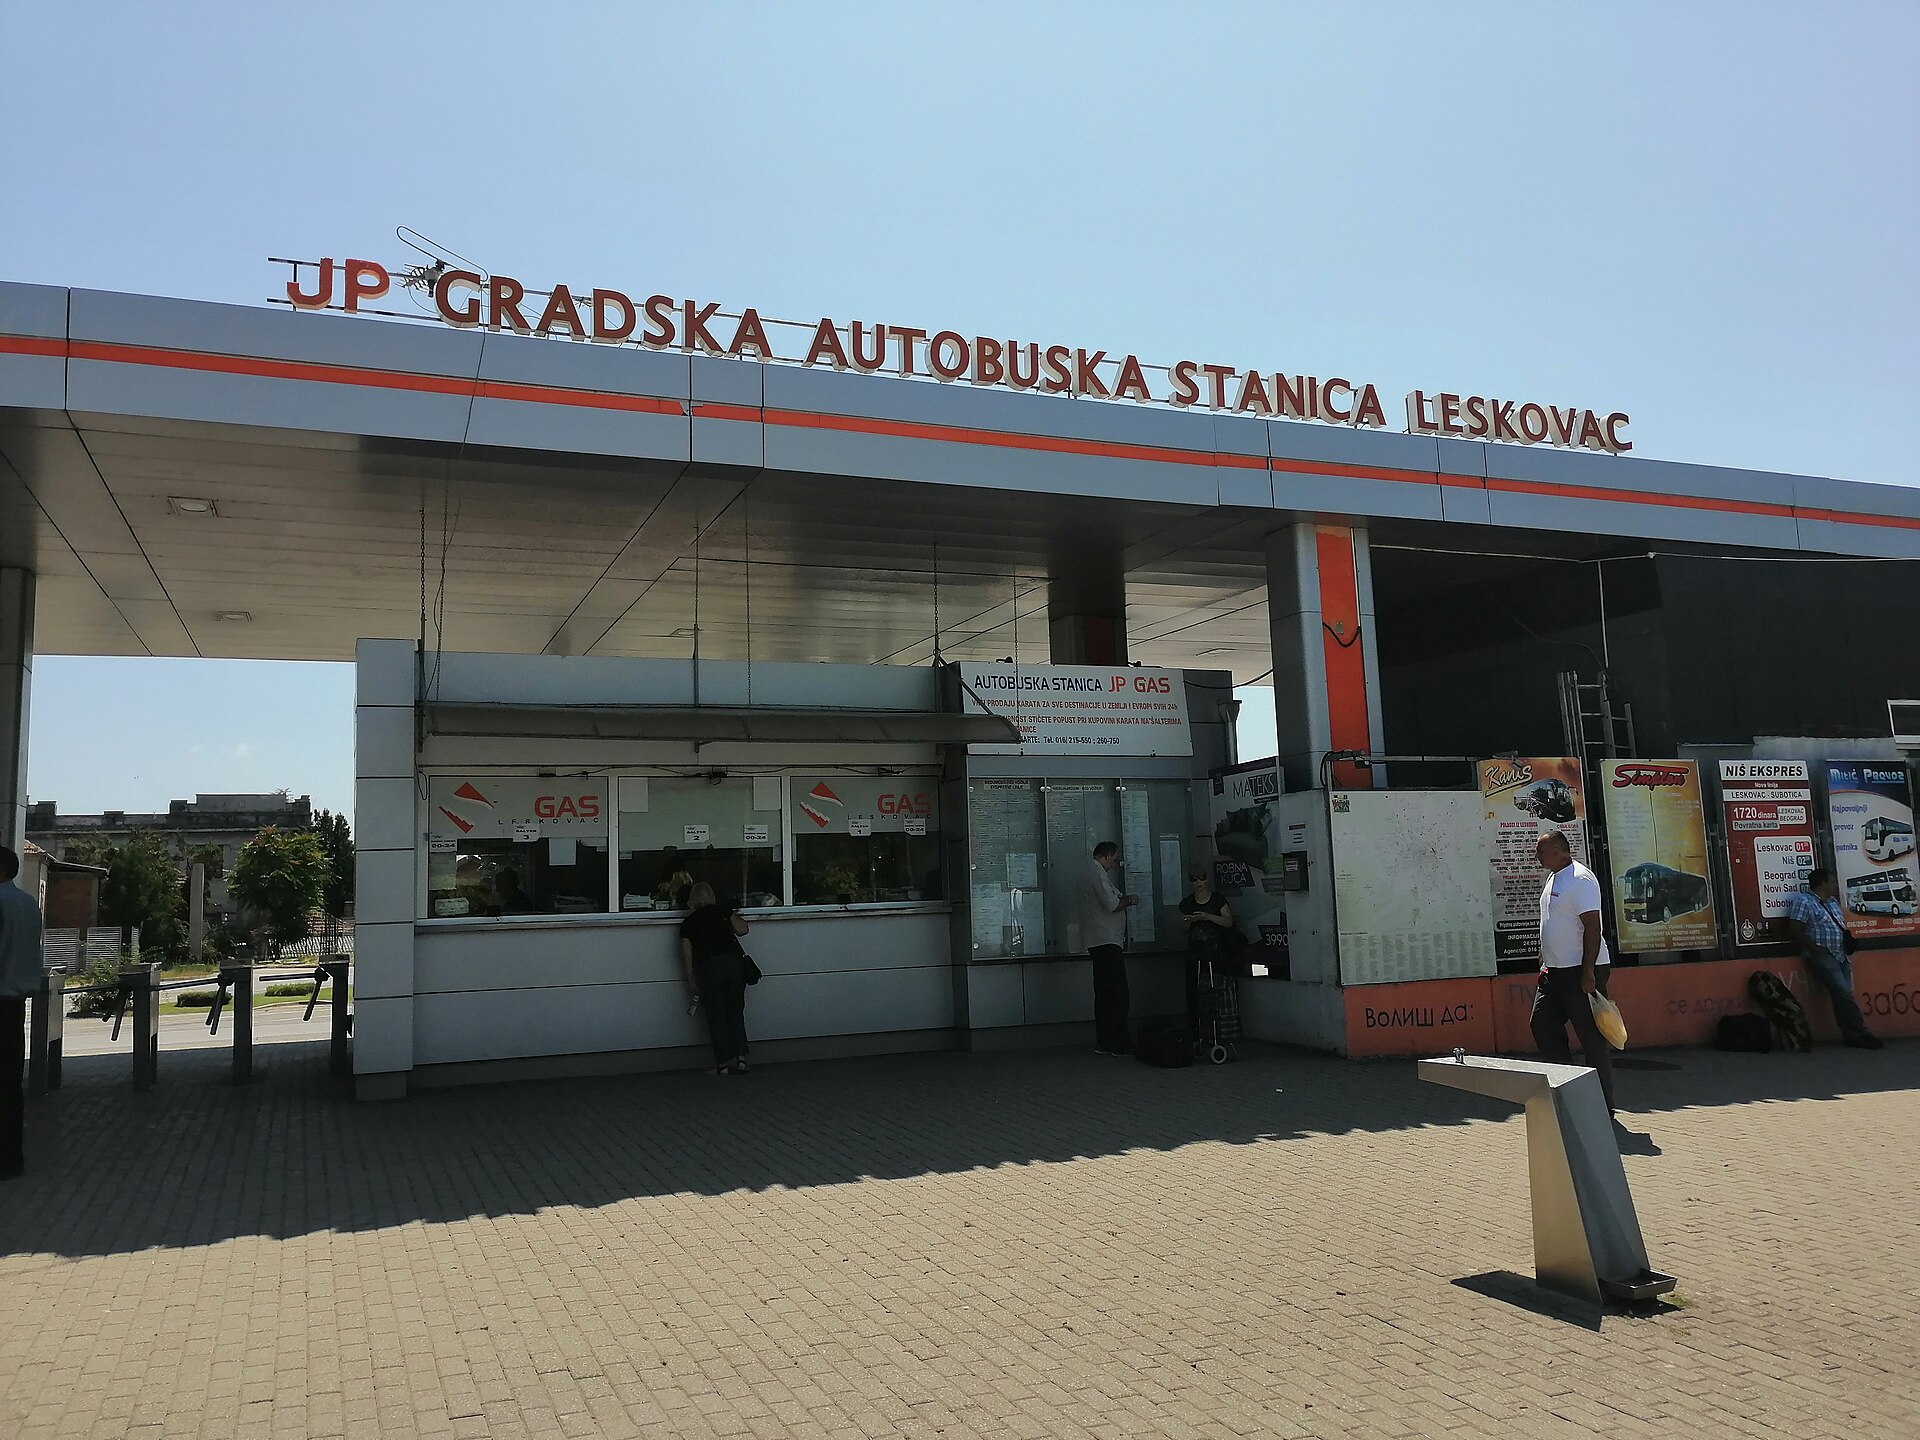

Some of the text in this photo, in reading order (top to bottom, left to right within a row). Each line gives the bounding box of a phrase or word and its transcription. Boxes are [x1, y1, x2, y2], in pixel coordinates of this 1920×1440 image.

[286, 256, 1635, 454] JP GRADSKA AUTOBUSKA STANICA LESKOVAC
[974, 675, 1171, 694] AUTOBUSKA STANICA JP GAS
[987, 699, 1015, 707] PRODAJU
[1017, 699, 1041, 708] KARATA
[1064, 701, 1101, 710] DESTINACIJE
[1053, 716, 1076, 724] POPUST
[1116, 717, 1140, 725] KARATA
[1726, 764, 1803, 777] NIŠ EKSPRES
[1232, 773, 1276, 800] MATEKS
[1731, 791, 1766, 799] LESKOVAC
[534, 796, 600, 819] GAS
[877, 794, 932, 815] GAS
[1733, 807, 1777, 819] 1720 dinara
[1756, 843, 1793, 852] Leskovac
[1782, 855, 1795, 865] Niš
[1215, 862, 1248, 874] ROBNA
[1764, 871, 1796, 881] Beograd
[1763, 884, 1782, 893] Novi
[1783, 883, 1798, 893] Sad
[1765, 899, 1794, 908] Suboti
